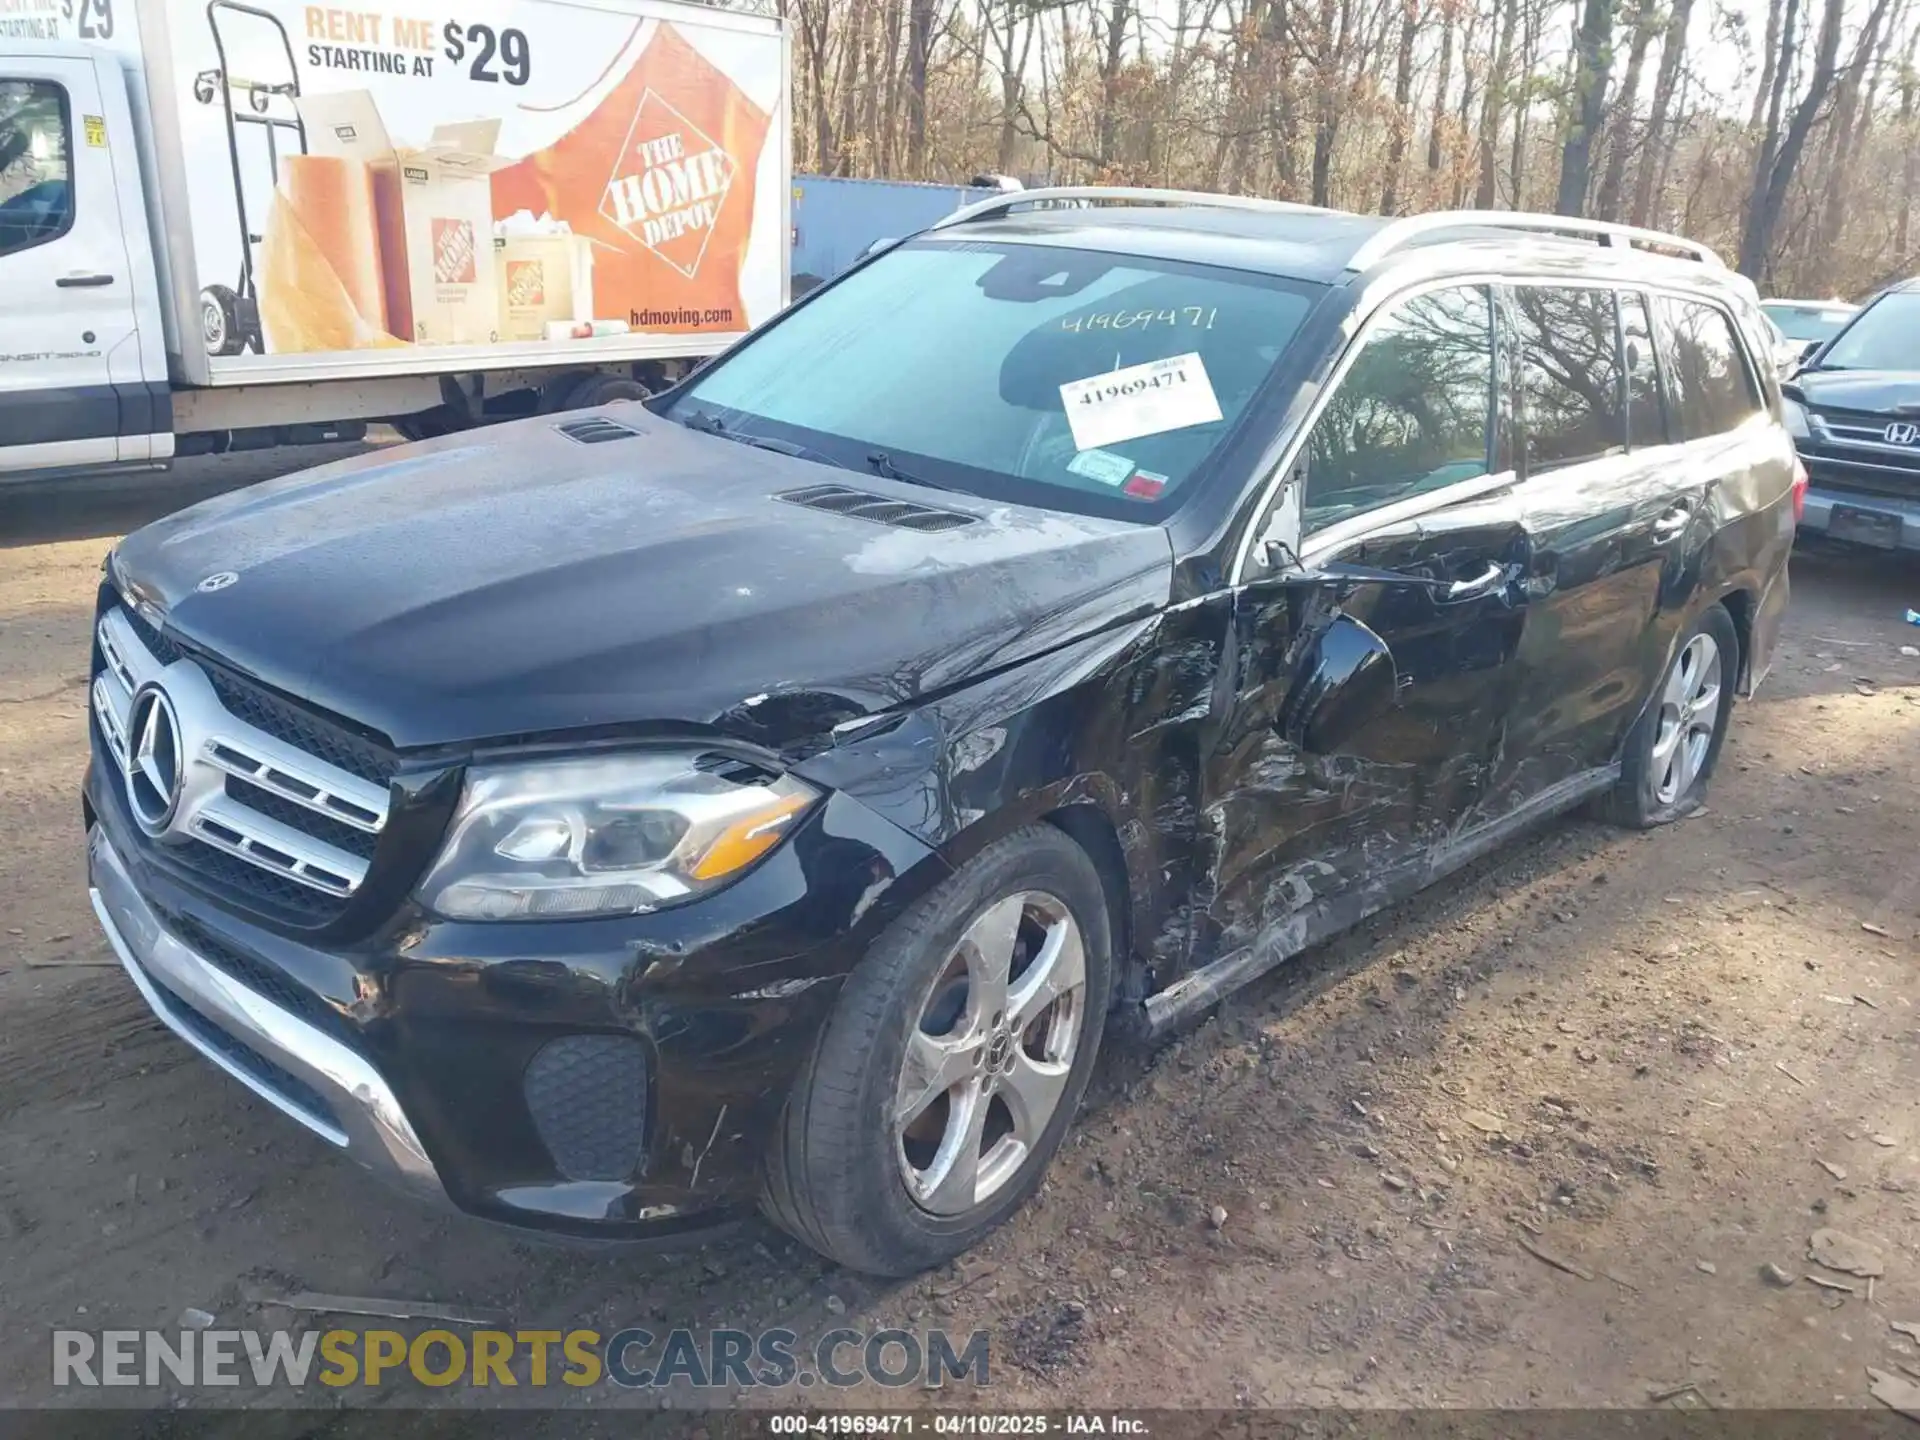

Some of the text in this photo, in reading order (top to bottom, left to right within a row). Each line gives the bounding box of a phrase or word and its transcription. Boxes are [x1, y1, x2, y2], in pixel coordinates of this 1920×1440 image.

[47, 17, 60, 40] AT
[305, 5, 436, 51] RENT ME
[308, 44, 435, 78] STARTING AT
[443, 19, 531, 86] $29
[637, 133, 685, 168] THE
[610, 147, 730, 226] HOME
[643, 201, 716, 248] DEPOT
[630, 306, 733, 327] hdmoving.com
[1061, 306, 1217, 333] 41969471
[1080, 369, 1187, 405] 41969471
